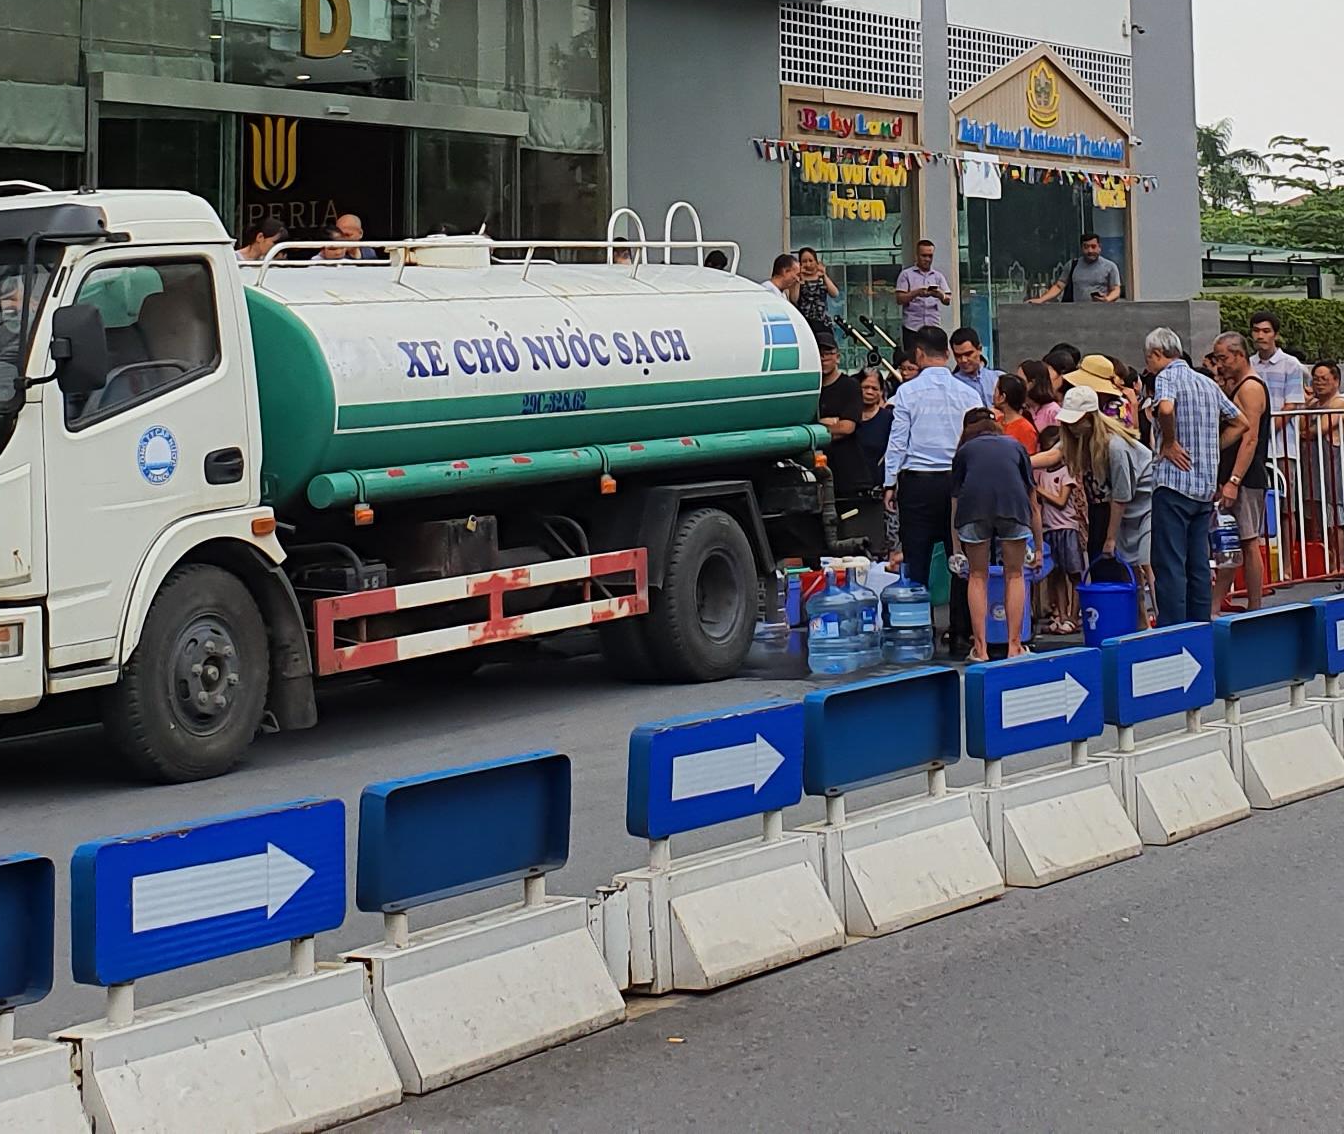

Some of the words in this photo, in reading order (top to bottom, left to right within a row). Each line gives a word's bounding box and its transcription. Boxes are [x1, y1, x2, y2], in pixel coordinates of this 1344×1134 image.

[798, 107, 853, 138] Baby
[855, 113, 903, 137] Land
[958, 117, 984, 150] Baby
[801, 151, 838, 184] Khu
[840, 163, 867, 184] vui
[248, 199, 338, 229] PERIA
[828, 188, 857, 220] trẻ
[858, 199, 887, 221] em
[398, 339, 449, 378] XE
[453, 320, 521, 376] CHỞ
[522, 318, 611, 371] NƯỚC
[613, 329, 691, 376] SẠCH
[522, 391, 587, 415] 29C-328.62
